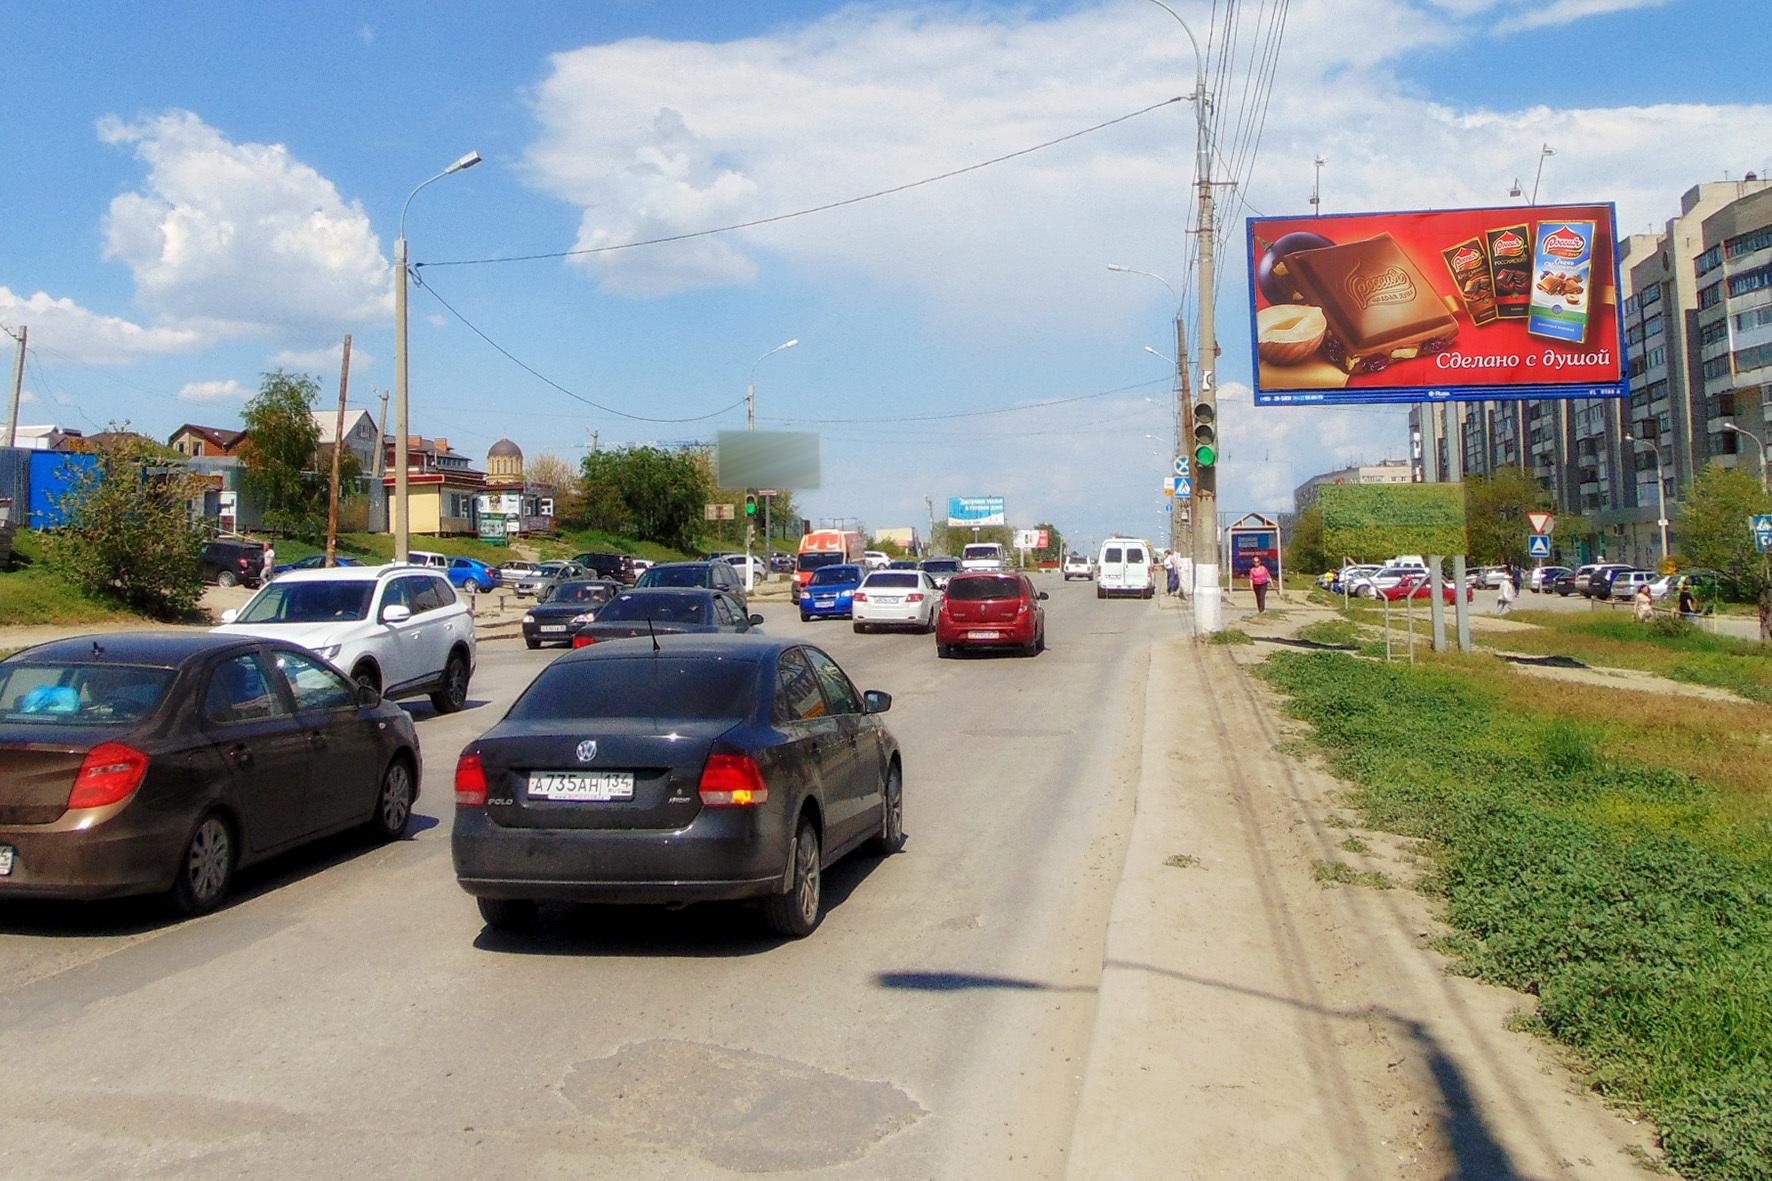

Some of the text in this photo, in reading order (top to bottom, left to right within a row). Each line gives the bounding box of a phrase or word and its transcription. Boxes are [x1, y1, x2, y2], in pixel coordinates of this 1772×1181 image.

[1436, 349, 1611, 370] Сделано с душой
[534, 774, 629, 792] А735АН 134
[487, 797, 513, 806] POLO
